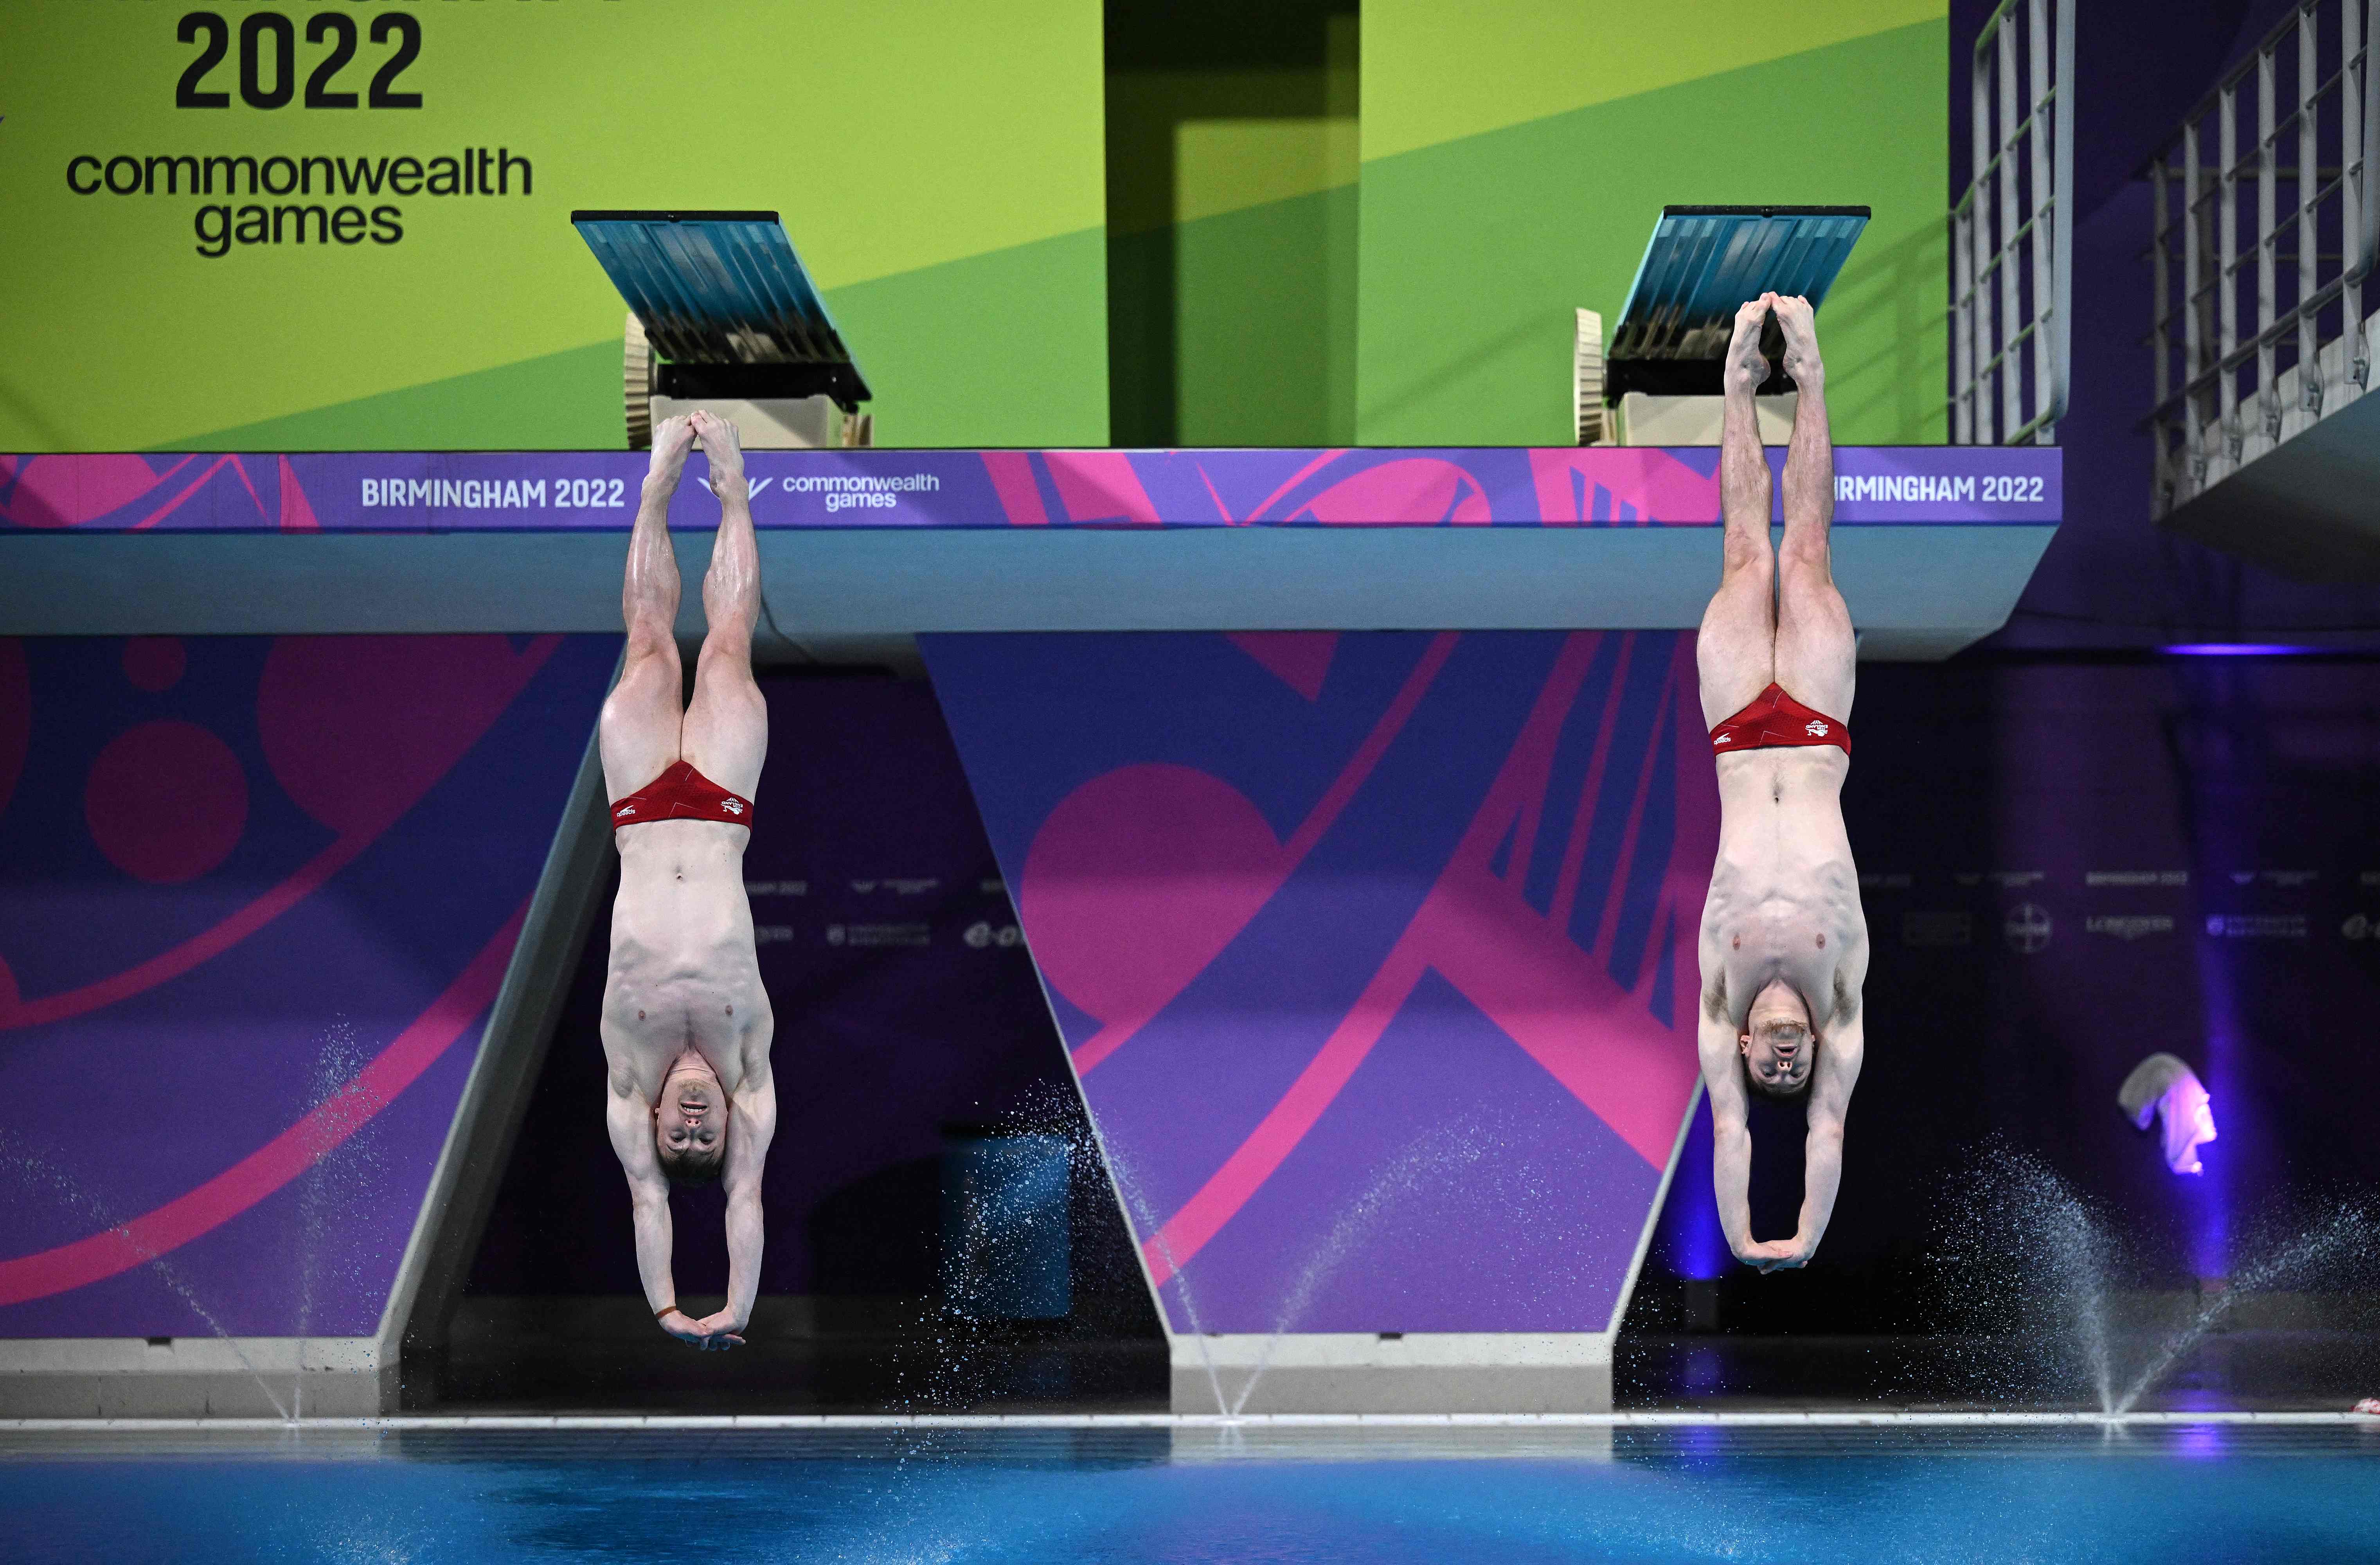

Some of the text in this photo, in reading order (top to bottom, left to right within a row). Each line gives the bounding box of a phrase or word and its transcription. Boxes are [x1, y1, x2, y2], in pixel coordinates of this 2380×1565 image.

[175, 11, 423, 110] 2022
[66, 148, 532, 196] commonwealth
[194, 205, 403, 258] games
[362, 478, 625, 508] BIRMINGHAM 2022
[783, 473, 939, 492] commonwealth
[1834, 476, 2044, 502] IRMINGHAM 2022
[825, 492, 897, 513] games
[617, 809, 635, 818] speedo
